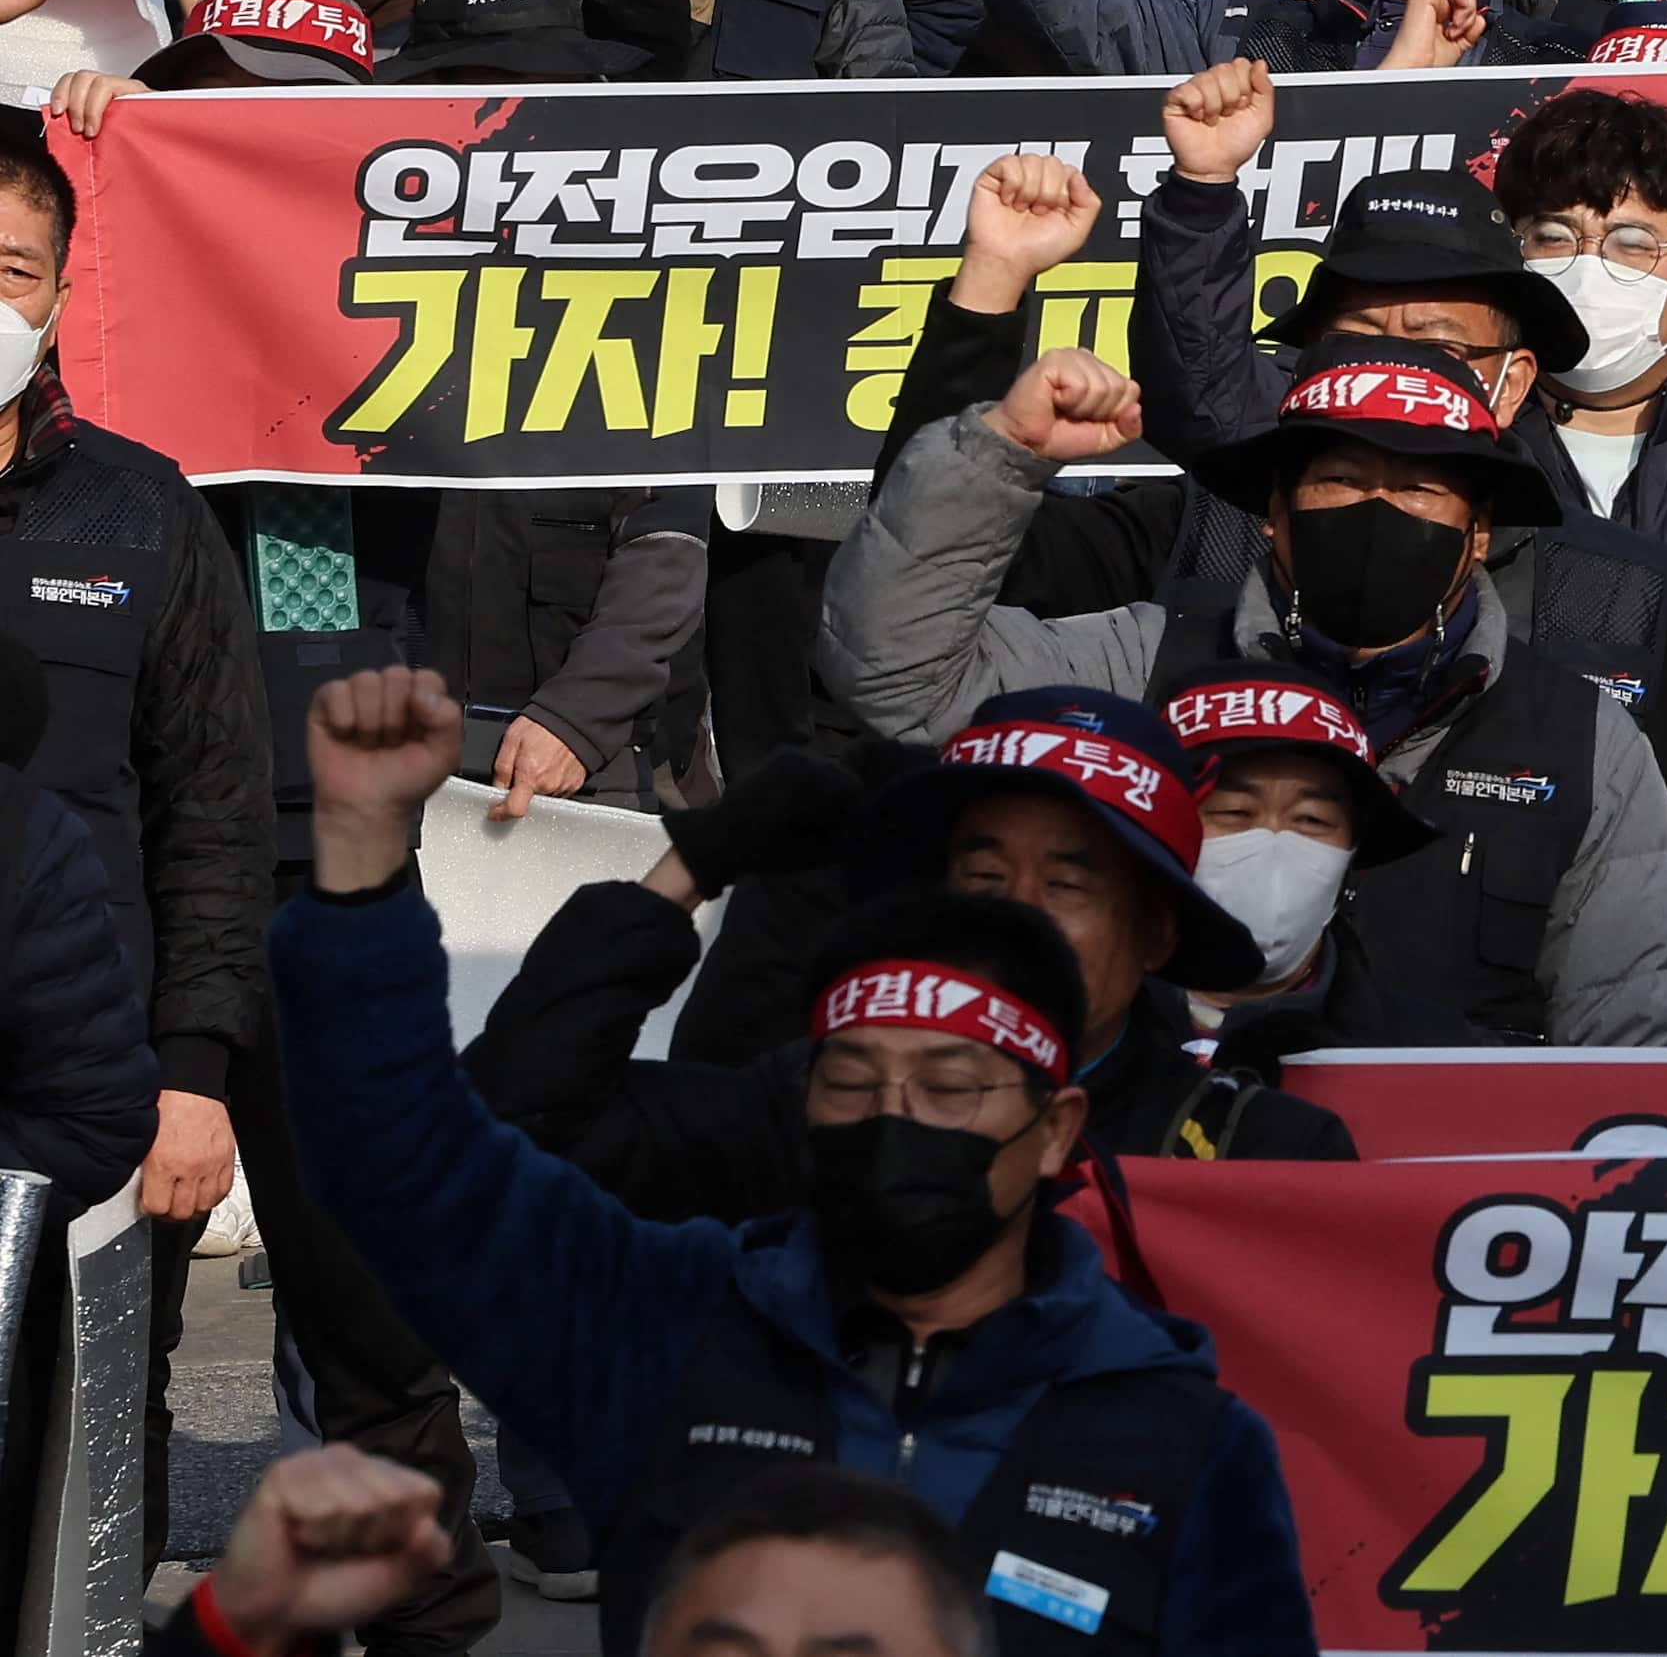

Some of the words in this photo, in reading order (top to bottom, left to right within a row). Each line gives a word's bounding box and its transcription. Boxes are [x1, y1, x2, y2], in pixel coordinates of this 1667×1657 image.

[311, 2, 369, 57] 투쟁
[340, 265, 782, 443] 가자!
[1386, 373, 1471, 430] 투쟁
[31, 585, 114, 608] 화물연대본부
[1167, 686, 1253, 736] 단결
[1060, 734, 1163, 812] 투쟁
[1445, 778, 1537, 805] 화물연대본부
[826, 969, 910, 1025] 단결
[977, 997, 1057, 1070] 투쟁
